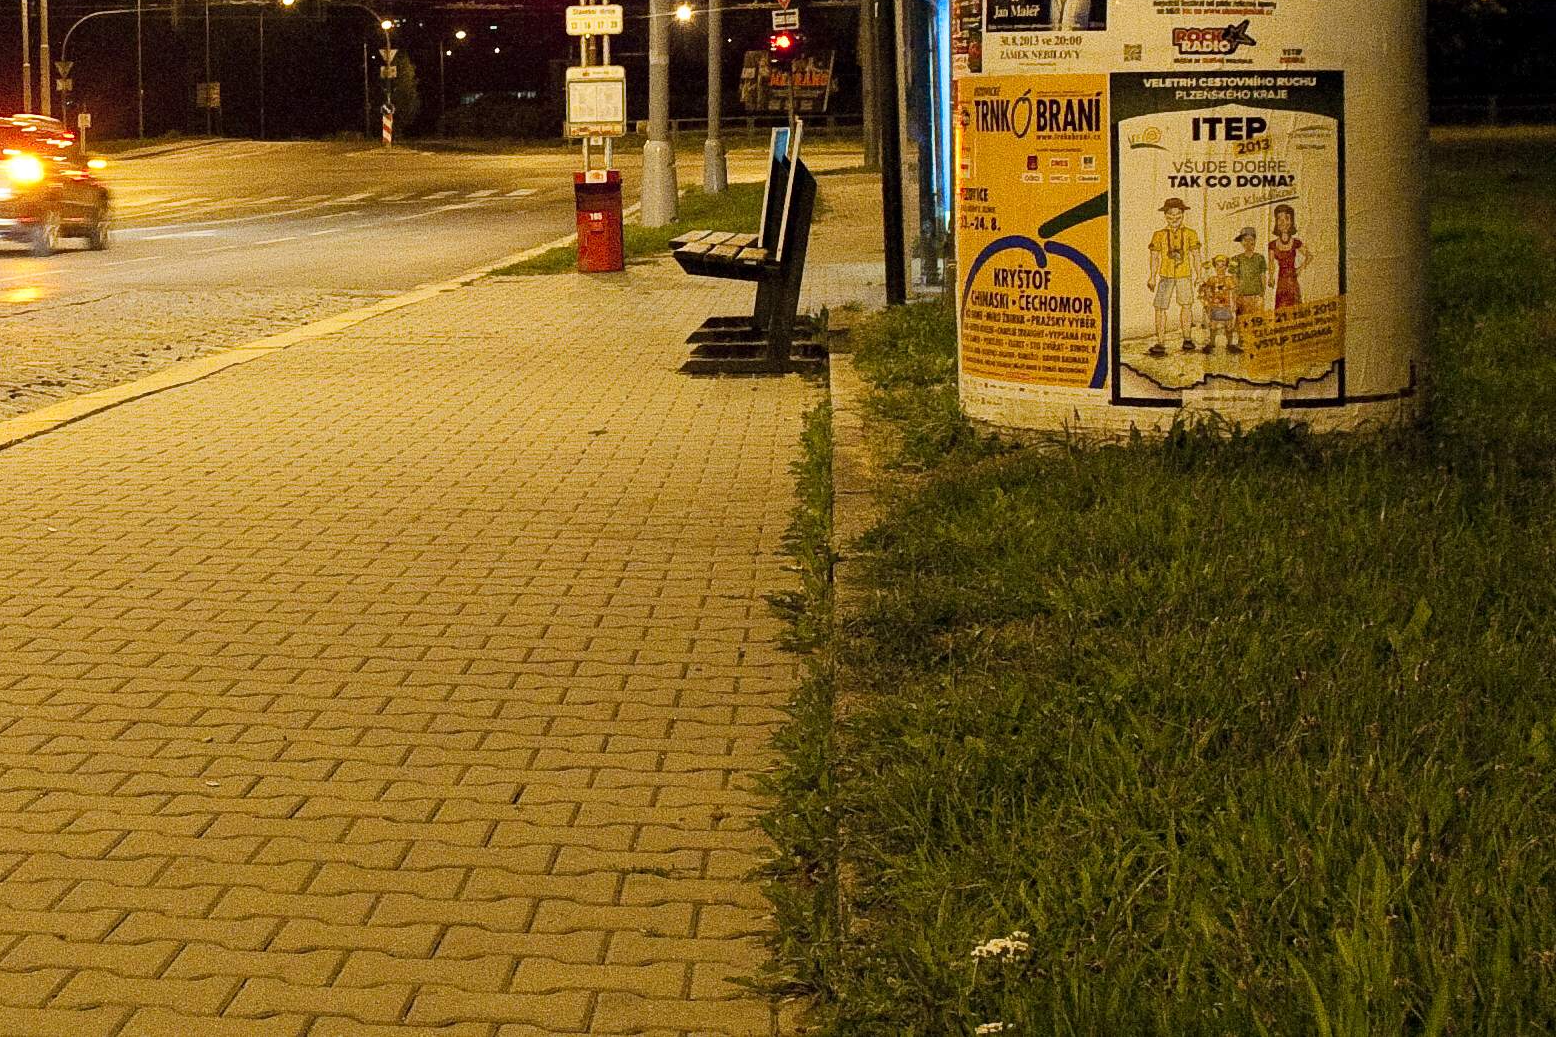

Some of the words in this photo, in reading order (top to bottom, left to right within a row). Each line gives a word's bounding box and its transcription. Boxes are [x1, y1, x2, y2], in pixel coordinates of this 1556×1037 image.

[1174, 29, 1224, 42] ROCK
[1182, 40, 1231, 53] RADIO
[1144, 77, 1197, 88] VELETRH
[1199, 75, 1274, 88] CESTOVNÍHO
[1276, 76, 1317, 87] RUCHU
[1175, 89, 1251, 100] PLZEŇSKÉHO
[1253, 89, 1288, 100] KRAJE
[1192, 116, 1268, 141] ITEP
[1237, 138, 1271, 156] 2013
[1172, 158, 1228, 174] VŠUDE
[1168, 175, 1201, 189] TAK
[1205, 175, 1231, 189] CO
[1236, 175, 1295, 189] DOMA?
[994, 264, 1052, 290] KRYŠTOF
[1018, 290, 1093, 314] ČECHOMOR
